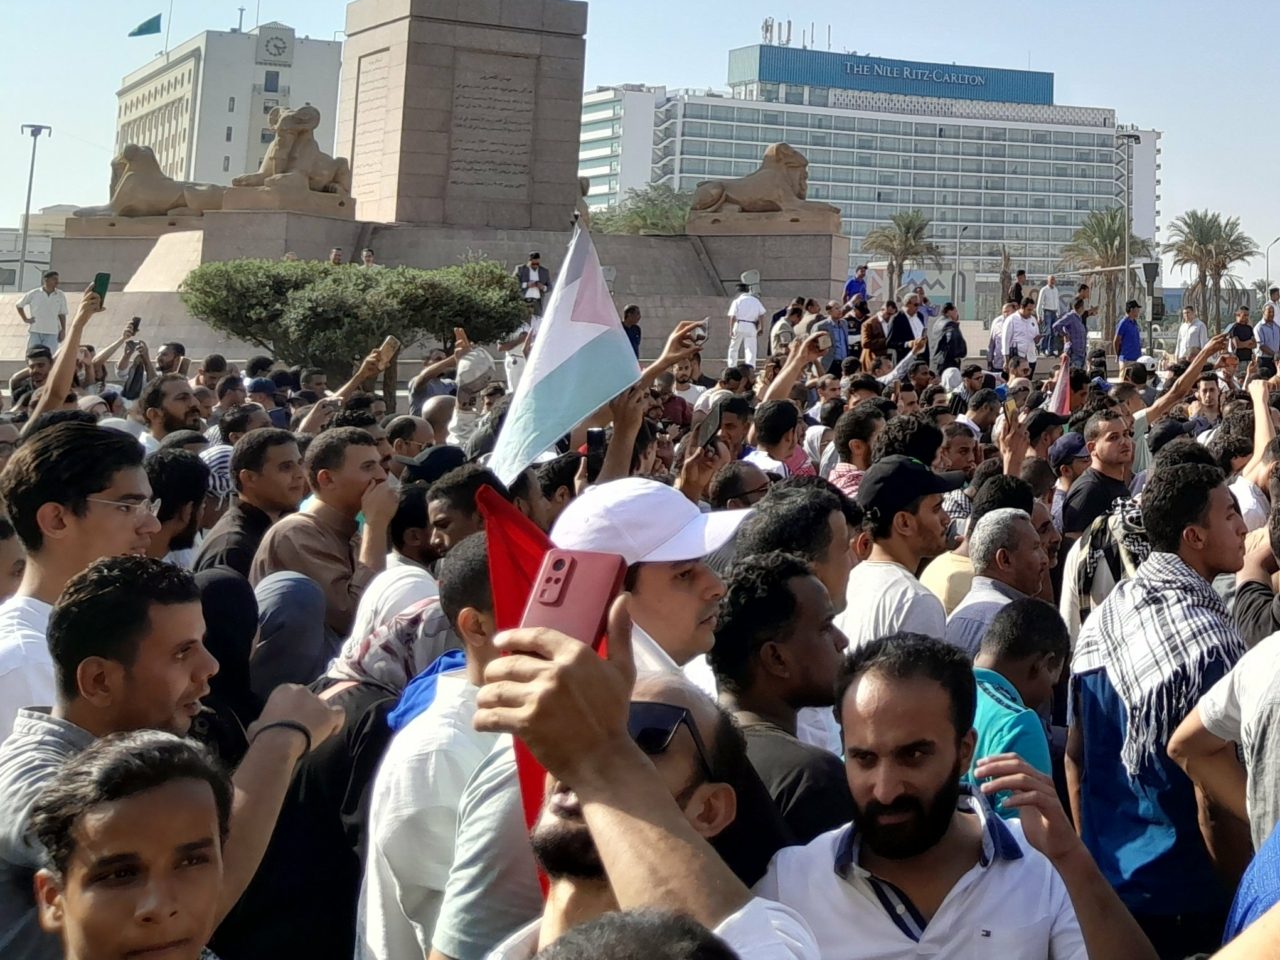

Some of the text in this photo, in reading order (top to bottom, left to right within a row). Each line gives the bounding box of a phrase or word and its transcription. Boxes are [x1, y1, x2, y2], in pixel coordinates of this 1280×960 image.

[845, 62, 986, 86] THE NILE RITZ-CARLTON
